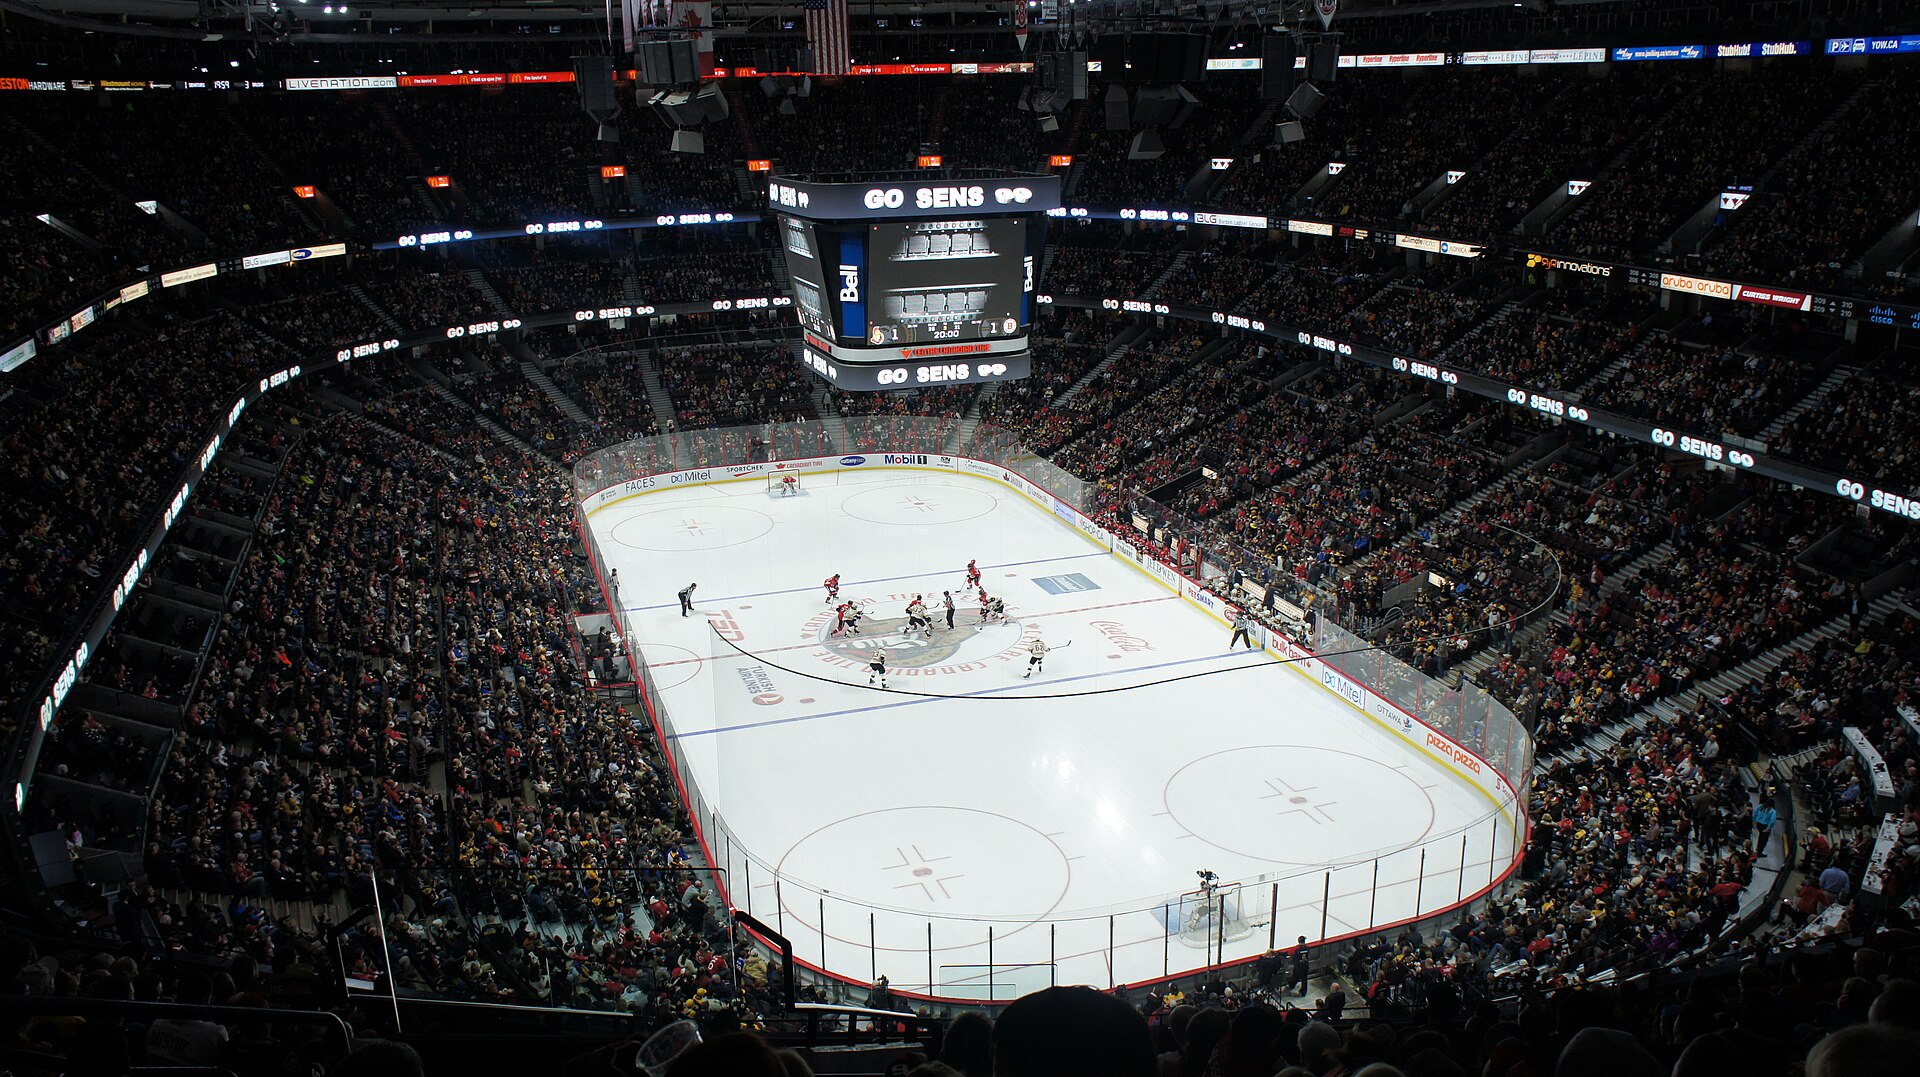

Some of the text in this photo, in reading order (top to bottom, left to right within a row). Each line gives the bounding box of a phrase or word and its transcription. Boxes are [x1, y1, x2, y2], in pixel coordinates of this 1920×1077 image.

[1717, 43, 1752, 57] StubHub!
[1871, 40, 1898, 50] YOW.CA
[28, 81, 66, 91] HARDWARE
[288, 79, 395, 90] LIVENATION.com
[770, 183, 796, 207] GO SENS
[864, 186, 984, 209] GO SENS
[657, 213, 733, 225] GO SENS GO
[1120, 209, 1189, 220] GO SENS GO
[1196, 213, 1217, 224] BLG
[526, 221, 602, 234] GO SENS GO
[399, 231, 472, 246] GO SENS GO
[1449, 245, 1467, 253] KONICA
[1024, 256, 1033, 292] Bell
[839, 265, 859, 302] Bell
[1663, 276, 1693, 289] aruba
[1697, 281, 1729, 295] aruba
[713, 297, 791, 310] GO SENS GO
[1742, 290, 1801, 304] CURTISS WRIGHT
[576, 306, 654, 320] GO SENS GO
[1103, 299, 1169, 313] GO SENS GO
[1840, 309, 1852, 317] 210
[447, 319, 521, 338] GO SENS GO
[990, 322, 997, 333] 1
[1212, 312, 1264, 331] GO SENS GO
[891, 328, 898, 340] 1
[934, 330, 960, 339] 20:00
[338, 339, 399, 362] GO SENS GO
[914, 343, 990, 357] CENTRE CANADIAN TIRE
[1299, 332, 1351, 355] GO SENS GO
[270, 370, 288, 387] SENS
[290, 366, 300, 377] GO
[877, 364, 970, 386] GO SENS
[1393, 358, 1457, 384] GO SENS GO
[1508, 389, 1588, 420] GO SENS GO
[1652, 429, 1753, 468] GO SENS GO
[884, 454, 916, 464] Mobil
[684, 468, 711, 482] Mitel
[726, 464, 764, 474] SPORTCHEK
[625, 478, 656, 492] FACES
[1837, 479, 1864, 500] GO
[1871, 490, 1920, 519] SENS
[887, 592, 936, 600] TIRE
[1187, 586, 1214, 609] PETSMART
[704, 609, 746, 642] TSN
[1088, 620, 1157, 653] Coca-Cola
[1272, 635, 1288, 655] bulk
[812, 651, 857, 669] TIRE
[41, 642, 87, 731] GO SENS GO
[736, 666, 762, 695] AIRLINES
[750, 665, 777, 693] TURKISH
[1337, 678, 1362, 706] Mitel
[1376, 704, 1402, 725] OTTAWA
[1426, 733, 1481, 775] pizza pizza
